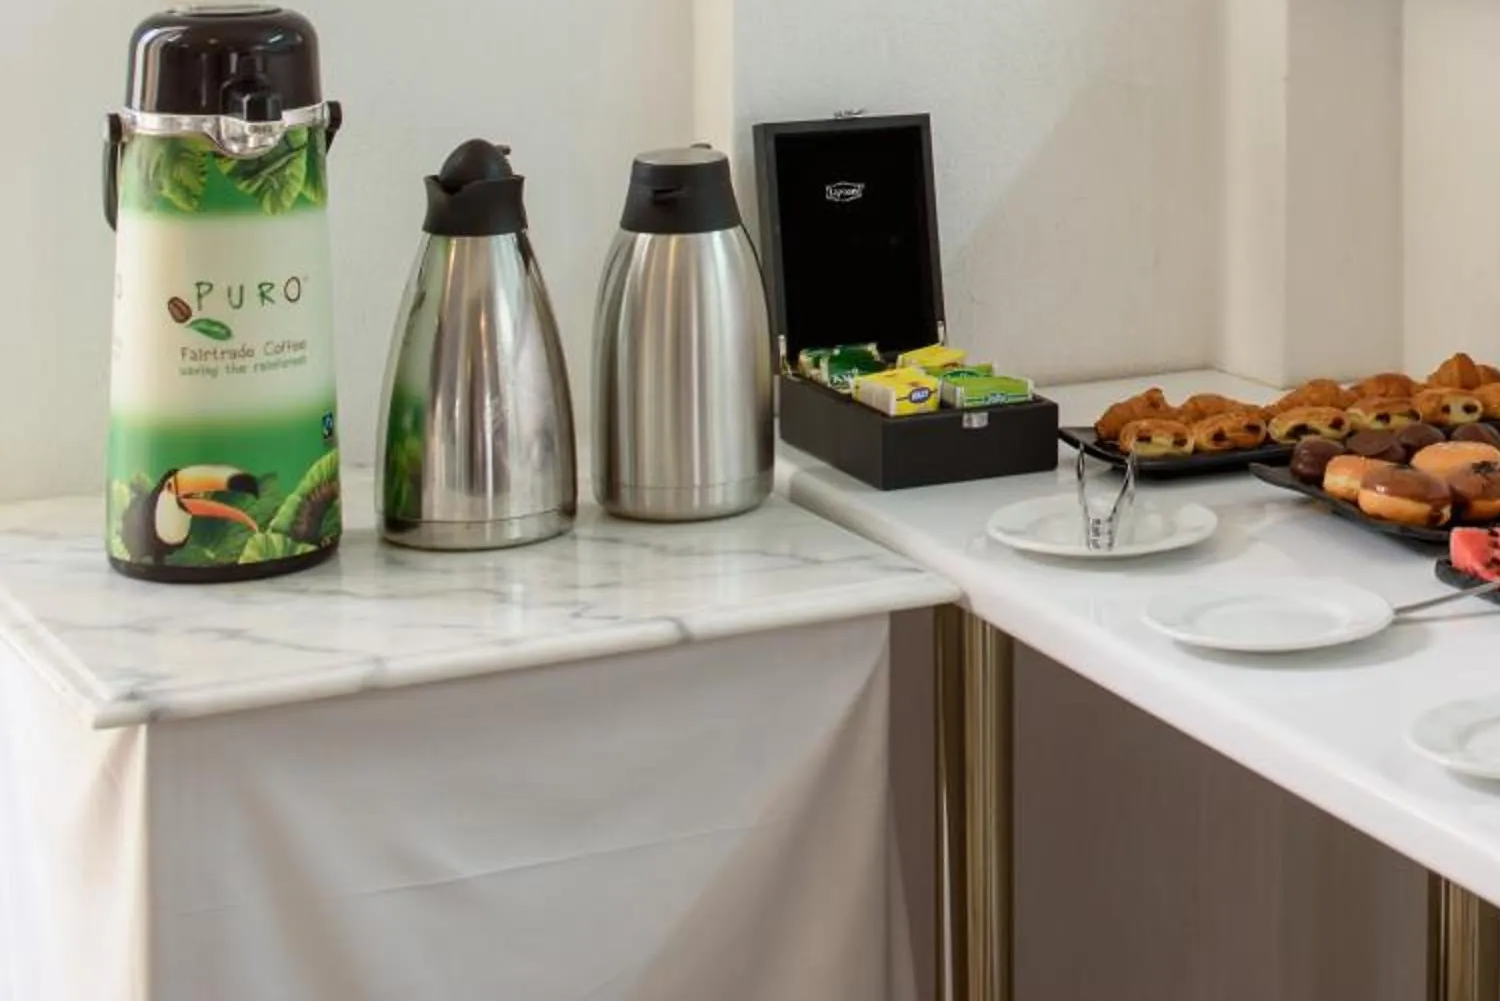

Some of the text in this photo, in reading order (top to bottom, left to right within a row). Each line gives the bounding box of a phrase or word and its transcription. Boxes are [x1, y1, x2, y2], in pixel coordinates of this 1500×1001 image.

[195, 276, 301, 311] PURO
[180, 340, 307, 362] Fairtrade Coffee
[225, 362, 248, 374] the
